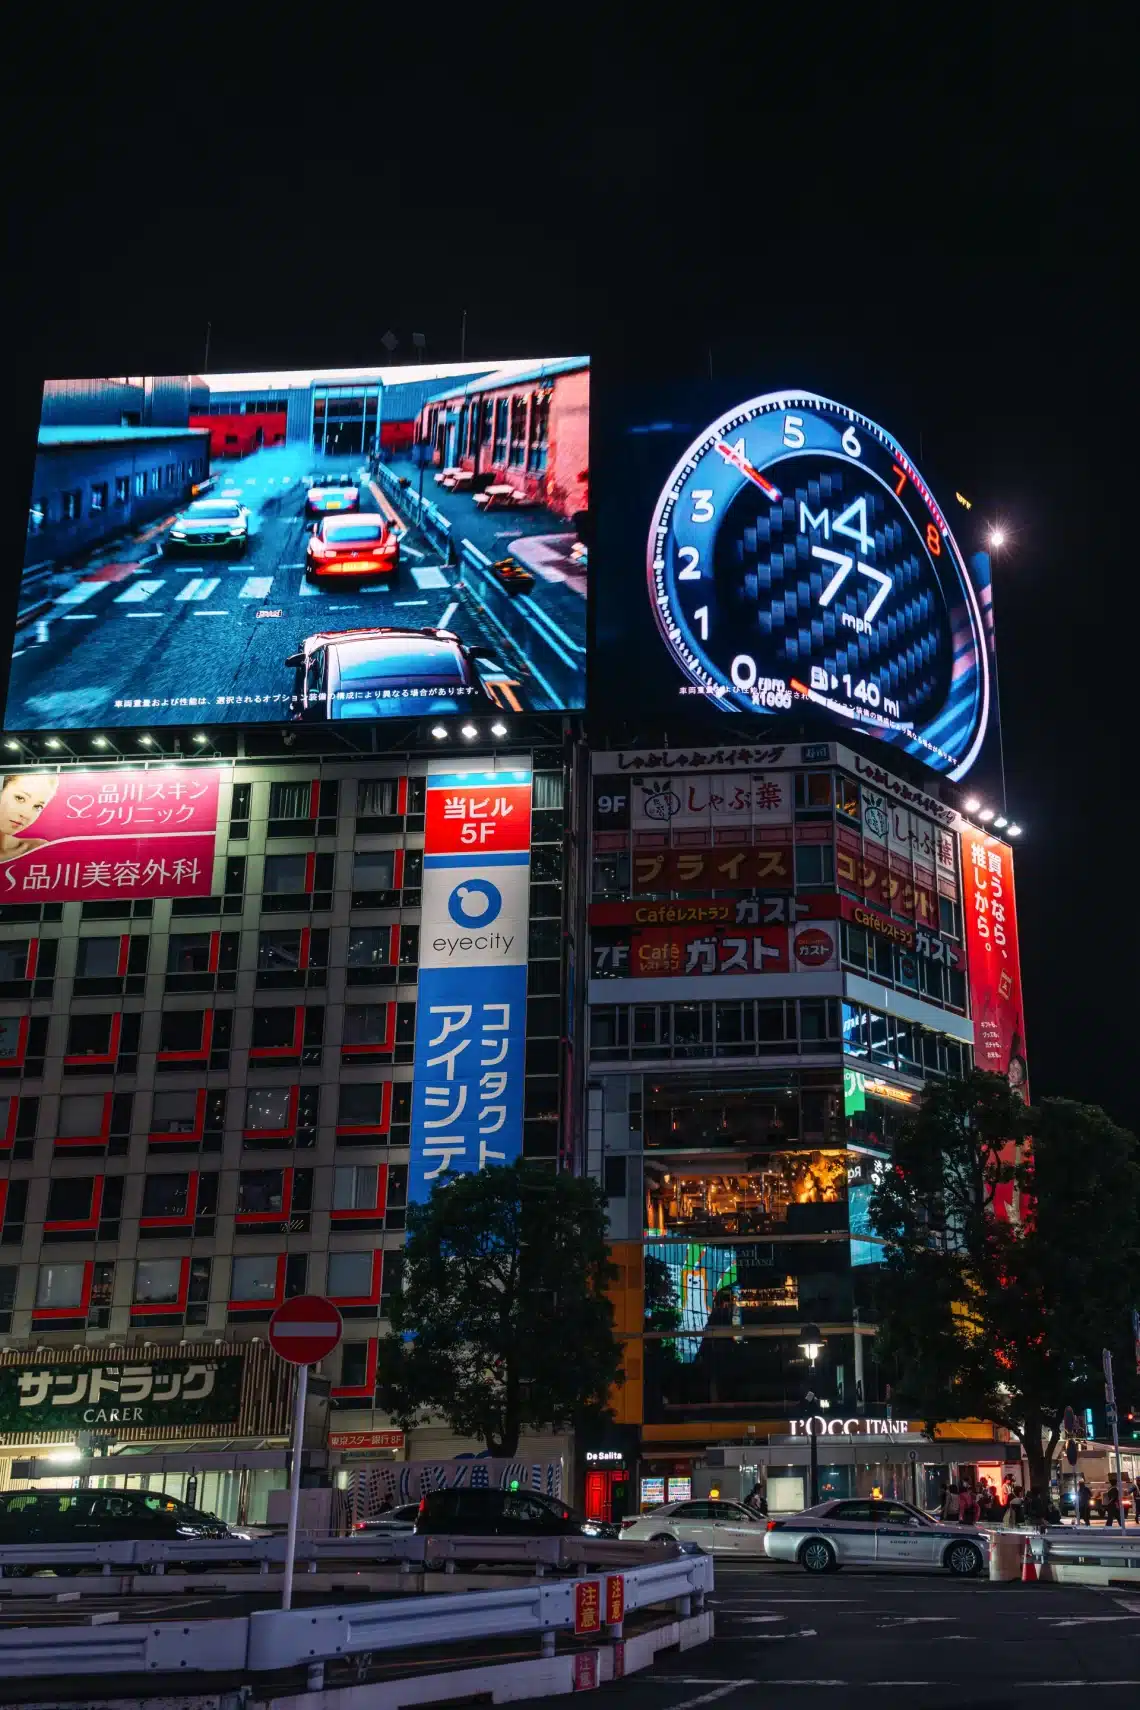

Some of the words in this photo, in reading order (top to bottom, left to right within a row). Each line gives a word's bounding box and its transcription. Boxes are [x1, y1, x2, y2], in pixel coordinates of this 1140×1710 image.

[783, 415, 805, 448] 5
[841, 426, 862, 458] 6
[892, 465, 907, 496] 7
[691, 489, 714, 523] 3
[799, 496, 875, 554] M4
[926, 524, 941, 556] 8
[678, 546, 701, 580] 2
[811, 545, 893, 623] 77
[694, 605, 709, 640] 1
[841, 611, 872, 636] mph
[731, 654, 757, 689] 0
[842, 674, 880, 707] 140
[617, 746, 785, 770] しゃぶしゃぶバイキング
[98, 781, 209, 804] 品川スキン
[443, 797, 513, 819] 当ビル
[597, 795, 627, 813] 9F
[688, 782, 783, 812] しゃぶ葉
[97, 803, 195, 826] クリニック
[460, 823, 496, 844] 5F
[22, 857, 202, 892] 品川美容外科
[635, 852, 787, 882] プライス
[736, 896, 809, 924] ガスト
[971, 843, 992, 952] 推しから。
[987, 850, 1008, 959] 買うなら、
[432, 933, 515, 952] eyecity
[639, 944, 680, 961] Café
[685, 936, 779, 974] ガスト
[17, 1364, 218, 1406] サンドラッグ
[83, 1407, 144, 1424] CARER
[586, 1452, 598, 1460] De
[581, 1587, 596, 1627] 注意
[612, 1580, 621, 1619] 注意
[579, 1655, 592, 1686] 注意
